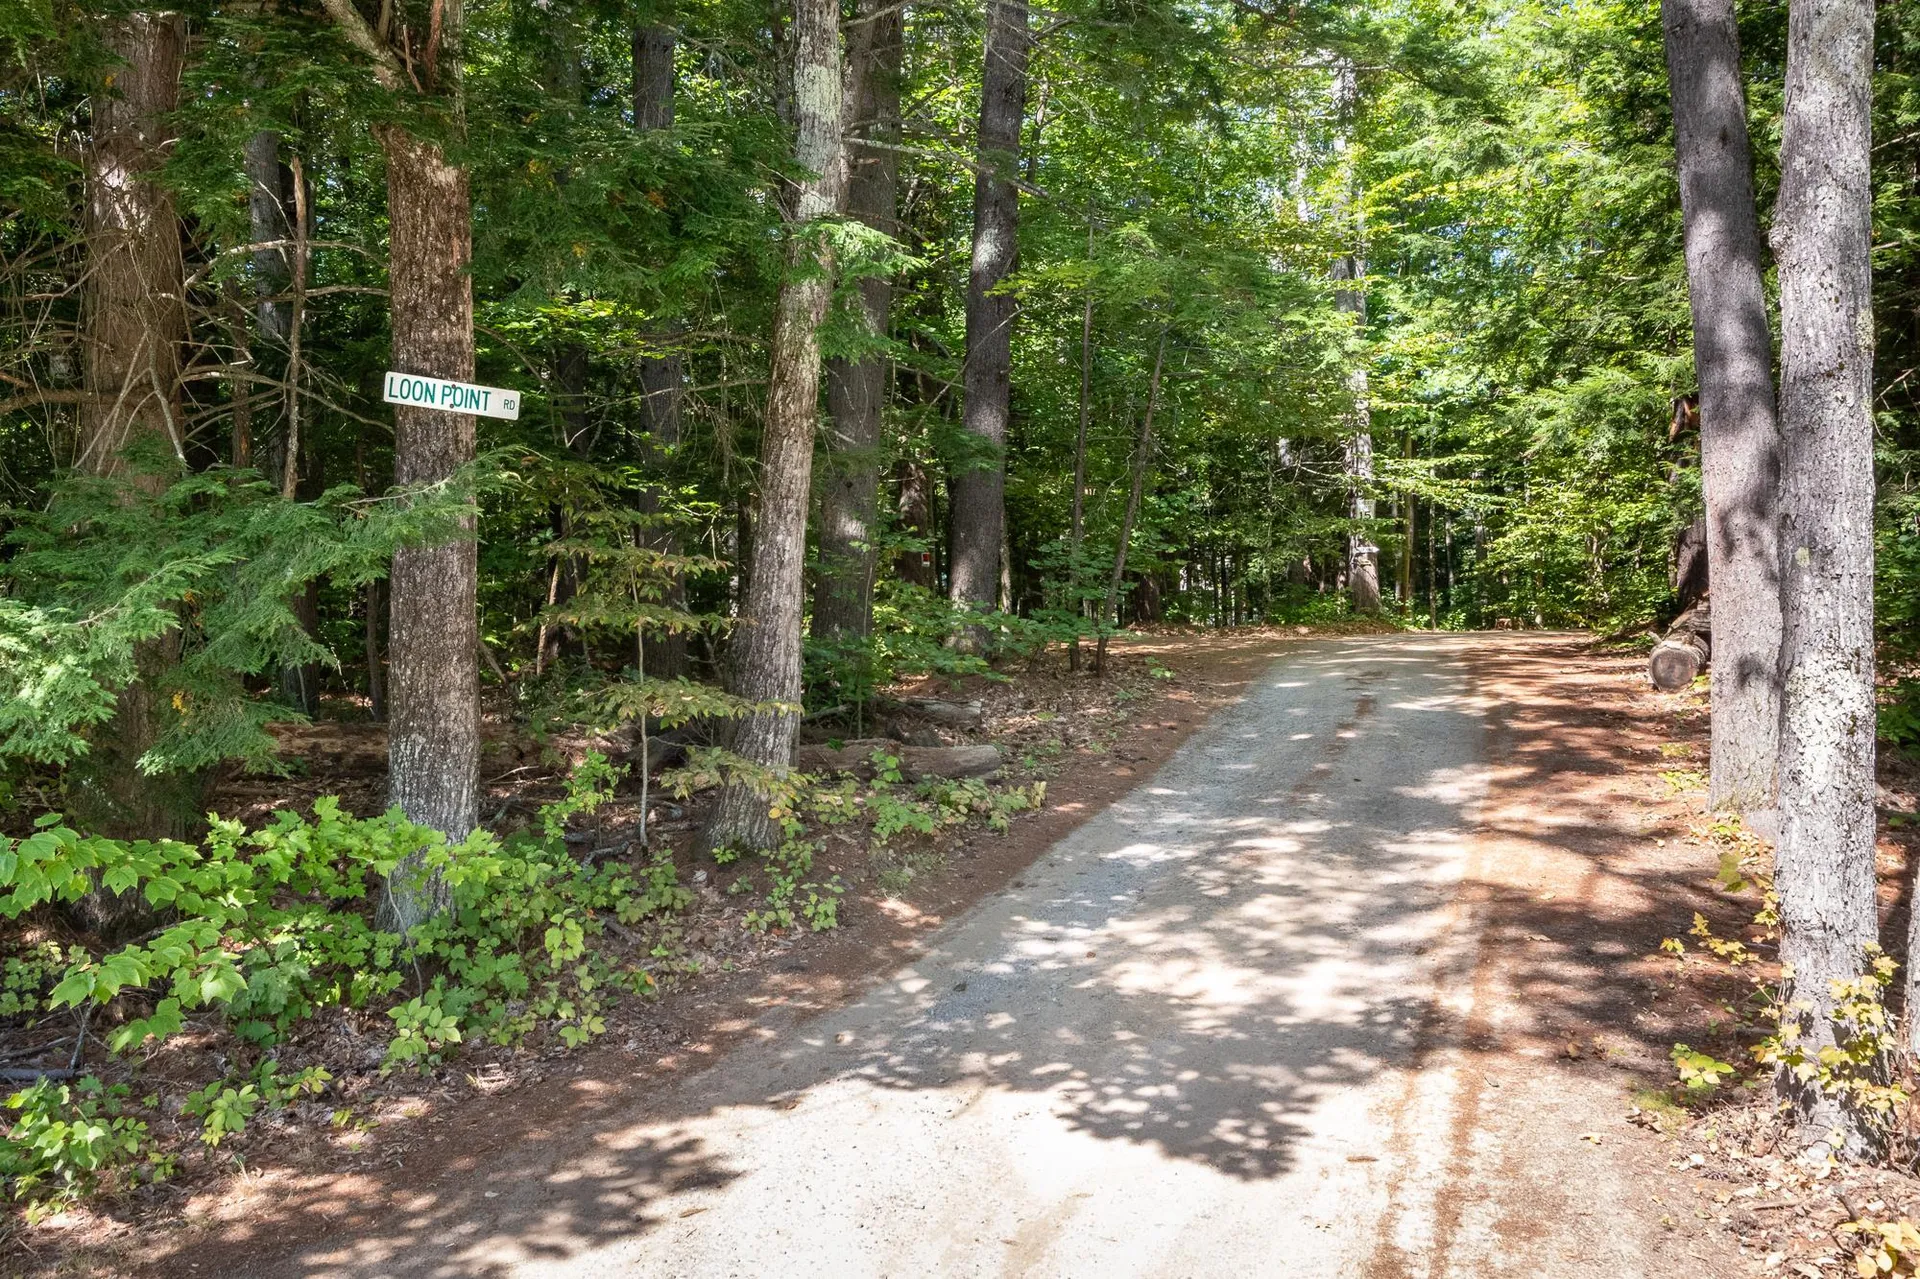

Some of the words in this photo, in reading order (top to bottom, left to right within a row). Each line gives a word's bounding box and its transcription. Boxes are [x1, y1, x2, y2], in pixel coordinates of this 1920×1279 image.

[388, 377, 436, 404] LOON
[441, 385, 491, 411] POINT
[503, 399, 516, 410] RD
[1360, 511, 1371, 520] 15
